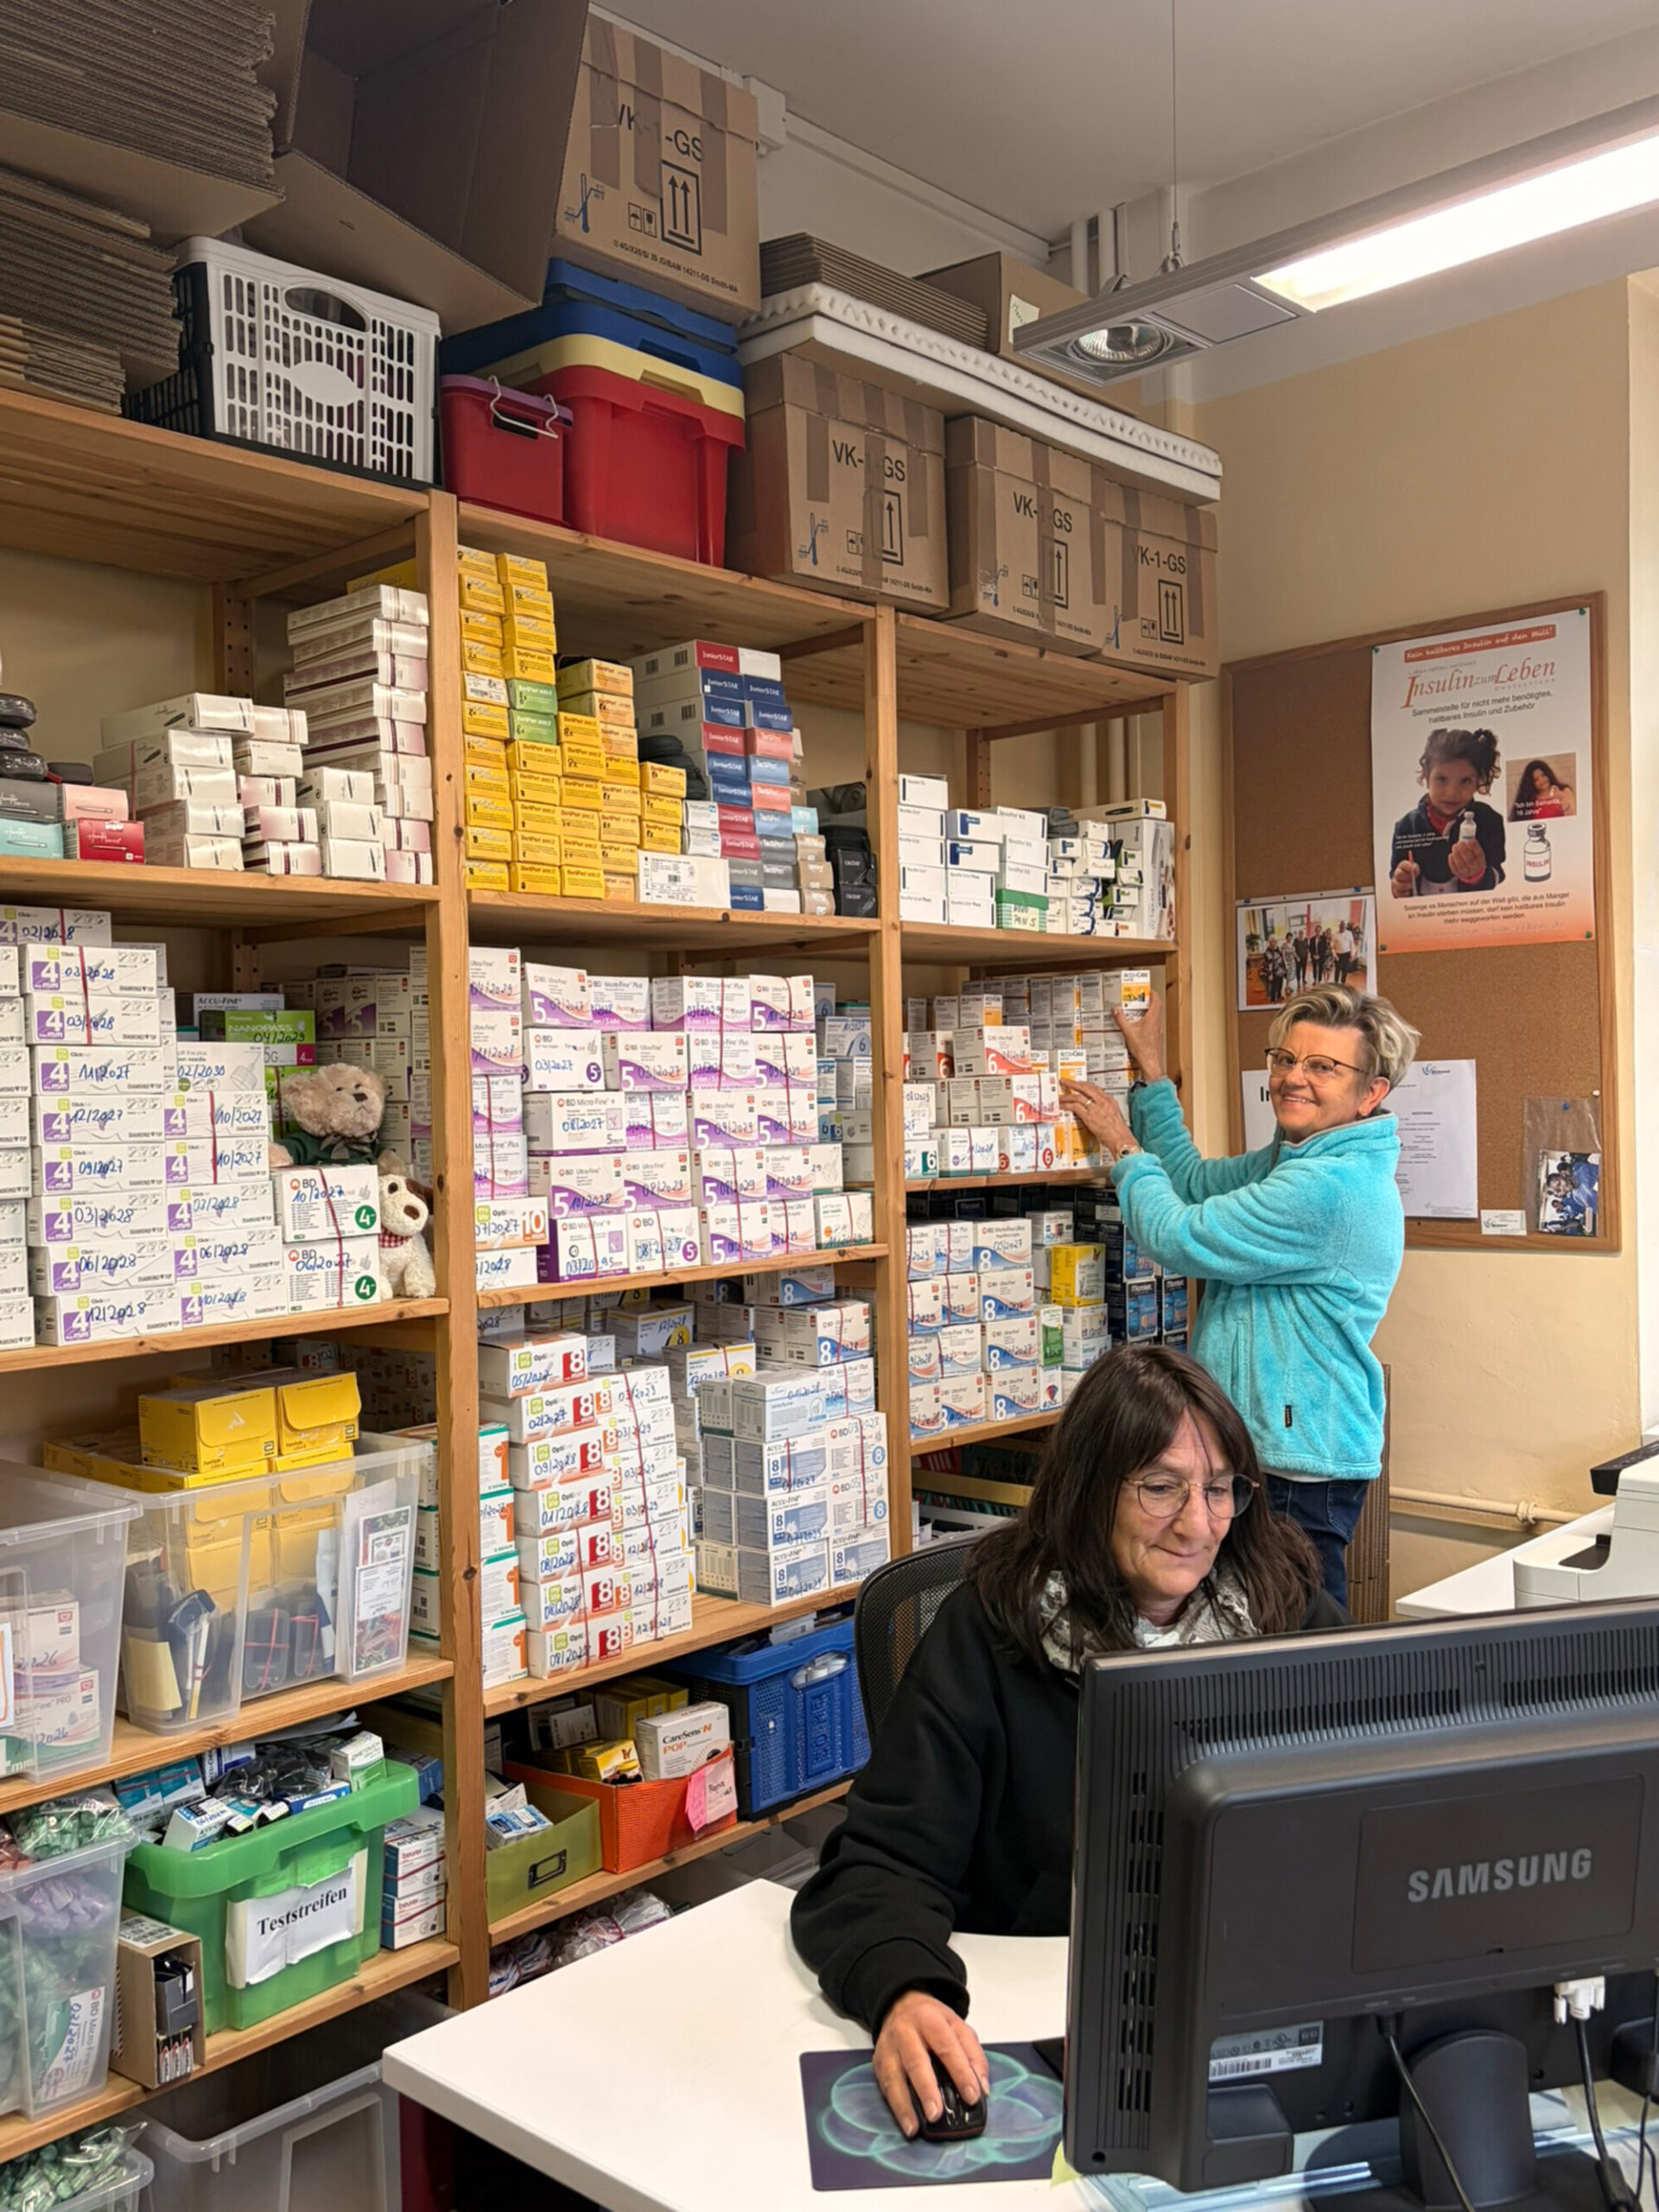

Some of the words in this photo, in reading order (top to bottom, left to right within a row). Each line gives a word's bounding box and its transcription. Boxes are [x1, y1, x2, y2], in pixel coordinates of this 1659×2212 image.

[1400, 669, 1476, 709] Insulin
[1494, 657, 1557, 684] Leben
[1412, 702, 1460, 717] Sammelstelle
[1460, 700, 1471, 710] für
[1472, 697, 1491, 709] nicht
[1491, 695, 1511, 705] mehr
[1428, 712, 1462, 724] haltbares
[1463, 709, 1487, 720] Insulin
[1488, 707, 1503, 716] und
[1504, 702, 1536, 715] Zubehör
[40, 961, 60, 984] 4
[532, 998, 547, 1021] 5
[752, 1006, 766, 1031] 5
[45, 1010, 64, 1033] 4
[229, 1024, 293, 1033] NANOPASS
[49, 1062, 68, 1085] 4
[589, 1065, 599, 1079] 5
[988, 1052, 999, 1075] 6
[621, 1067, 635, 1090] 5
[755, 1065, 768, 1089] 5
[51, 1113, 70, 1135] 4
[1016, 1103, 1027, 1123] 6
[696, 1124, 709, 1150] 5
[759, 1121, 771, 1145] 5
[53, 1161, 72, 1184] 4
[554, 1192, 569, 1218] 5
[623, 1186, 637, 1212] 5
[704, 1182, 718, 1207] 5
[54, 1211, 72, 1235] 4
[174, 1203, 192, 1224] 4
[179, 1249, 196, 1269] 4
[711, 1239, 726, 1266] 5
[60, 1262, 79, 1283] 4
[784, 1283, 794, 1304] 8
[185, 1296, 202, 1318] 4
[984, 1299, 995, 1320] 8
[73, 1311, 90, 1333] 4
[677, 1332, 684, 1344] 8
[570, 1350, 585, 1372] 8
[820, 1341, 832, 1363] 8
[989, 1349, 1000, 1370] 8
[579, 1394, 594, 1418] 8
[599, 1390, 611, 1408] 8
[995, 1398, 1007, 1421] 8
[606, 1428, 618, 1446] 8
[587, 1440, 602, 1465] 8
[772, 1459, 779, 1472] 8
[597, 1486, 611, 1514] 8
[776, 1514, 784, 1528] 8
[595, 1533, 610, 1556] 8
[836, 1552, 844, 1564] 8
[778, 1568, 785, 1581] 8
[598, 1579, 613, 1602] 8
[620, 1584, 631, 1602] 8
[606, 1626, 621, 1649] 8
[662, 1726, 702, 1745] CareSens
[662, 1741, 688, 1756] POP
[403, 1847, 423, 1859] beurer
[1408, 1847, 1593, 1904] SAMSUNG
[257, 1886, 348, 1936] Teststreifen
[398, 1897, 420, 1910] beurer
